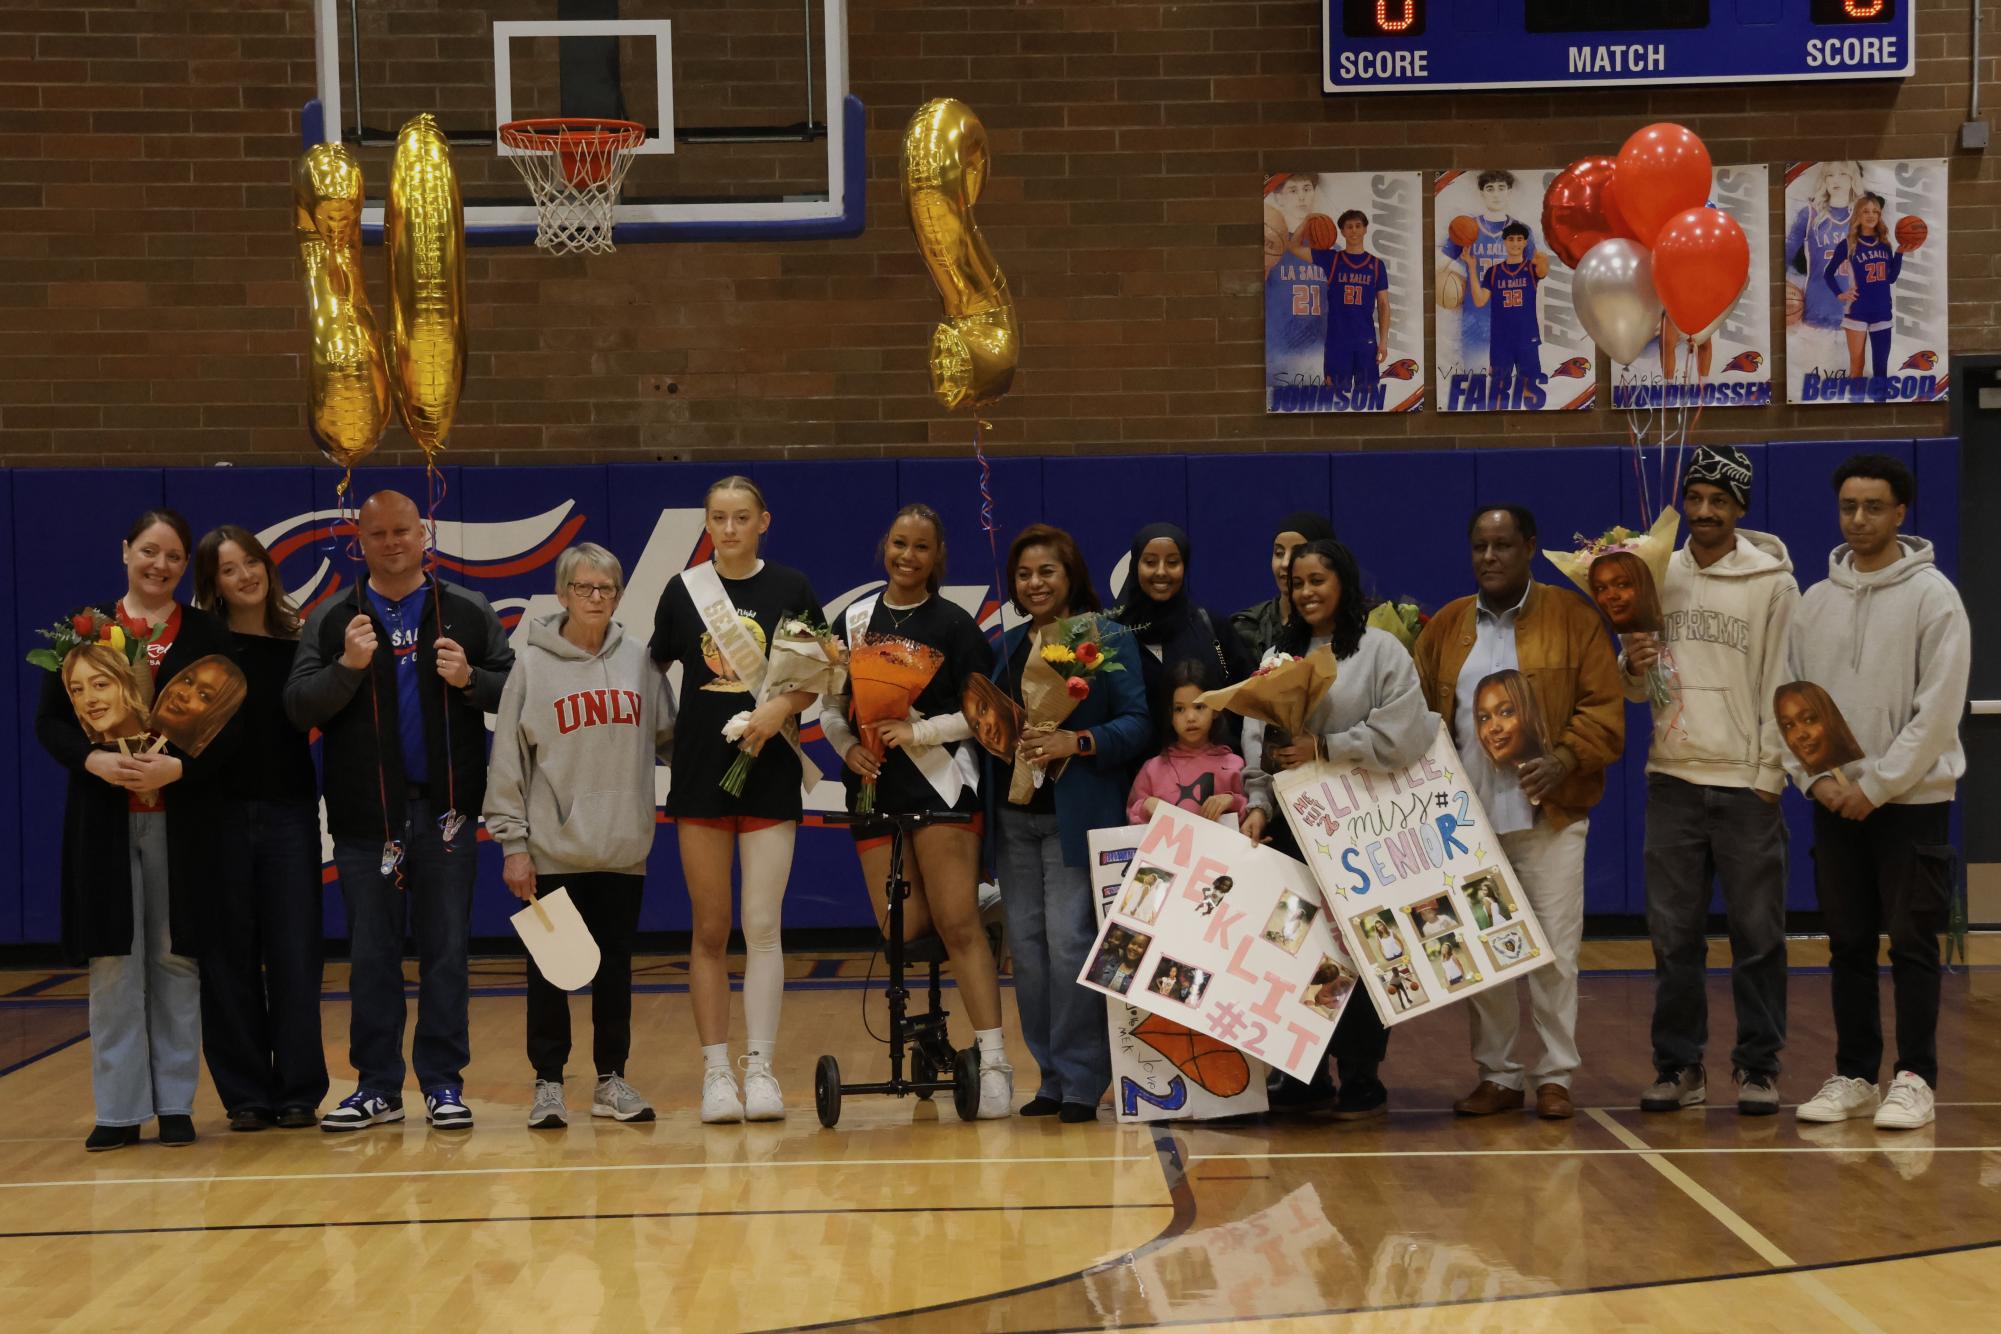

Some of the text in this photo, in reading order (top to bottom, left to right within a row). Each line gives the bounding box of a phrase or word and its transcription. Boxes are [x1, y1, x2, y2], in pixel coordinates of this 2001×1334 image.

[1339, 50, 1429, 79] SCORE
[1567, 44, 1666, 73] MATCH
[1806, 36, 1897, 67] SCORE
[1895, 162, 1936, 343] FALCNS
[1865, 261, 1886, 283] 20
[1292, 284, 1321, 316] 21
[1343, 285, 1363, 305] 21
[1503, 289, 1523, 308] 32
[1271, 384, 1387, 412] JOHNSON
[1448, 372, 1549, 411] FARIS
[1801, 372, 1937, 403] Bergeson
[553, 689, 642, 735] UNLV
[1347, 790, 1476, 839] miss #2
[1340, 813, 1470, 895] SENIOR
[1205, 1000, 1268, 1057] #2
[1120, 1074, 1188, 1117] 2
